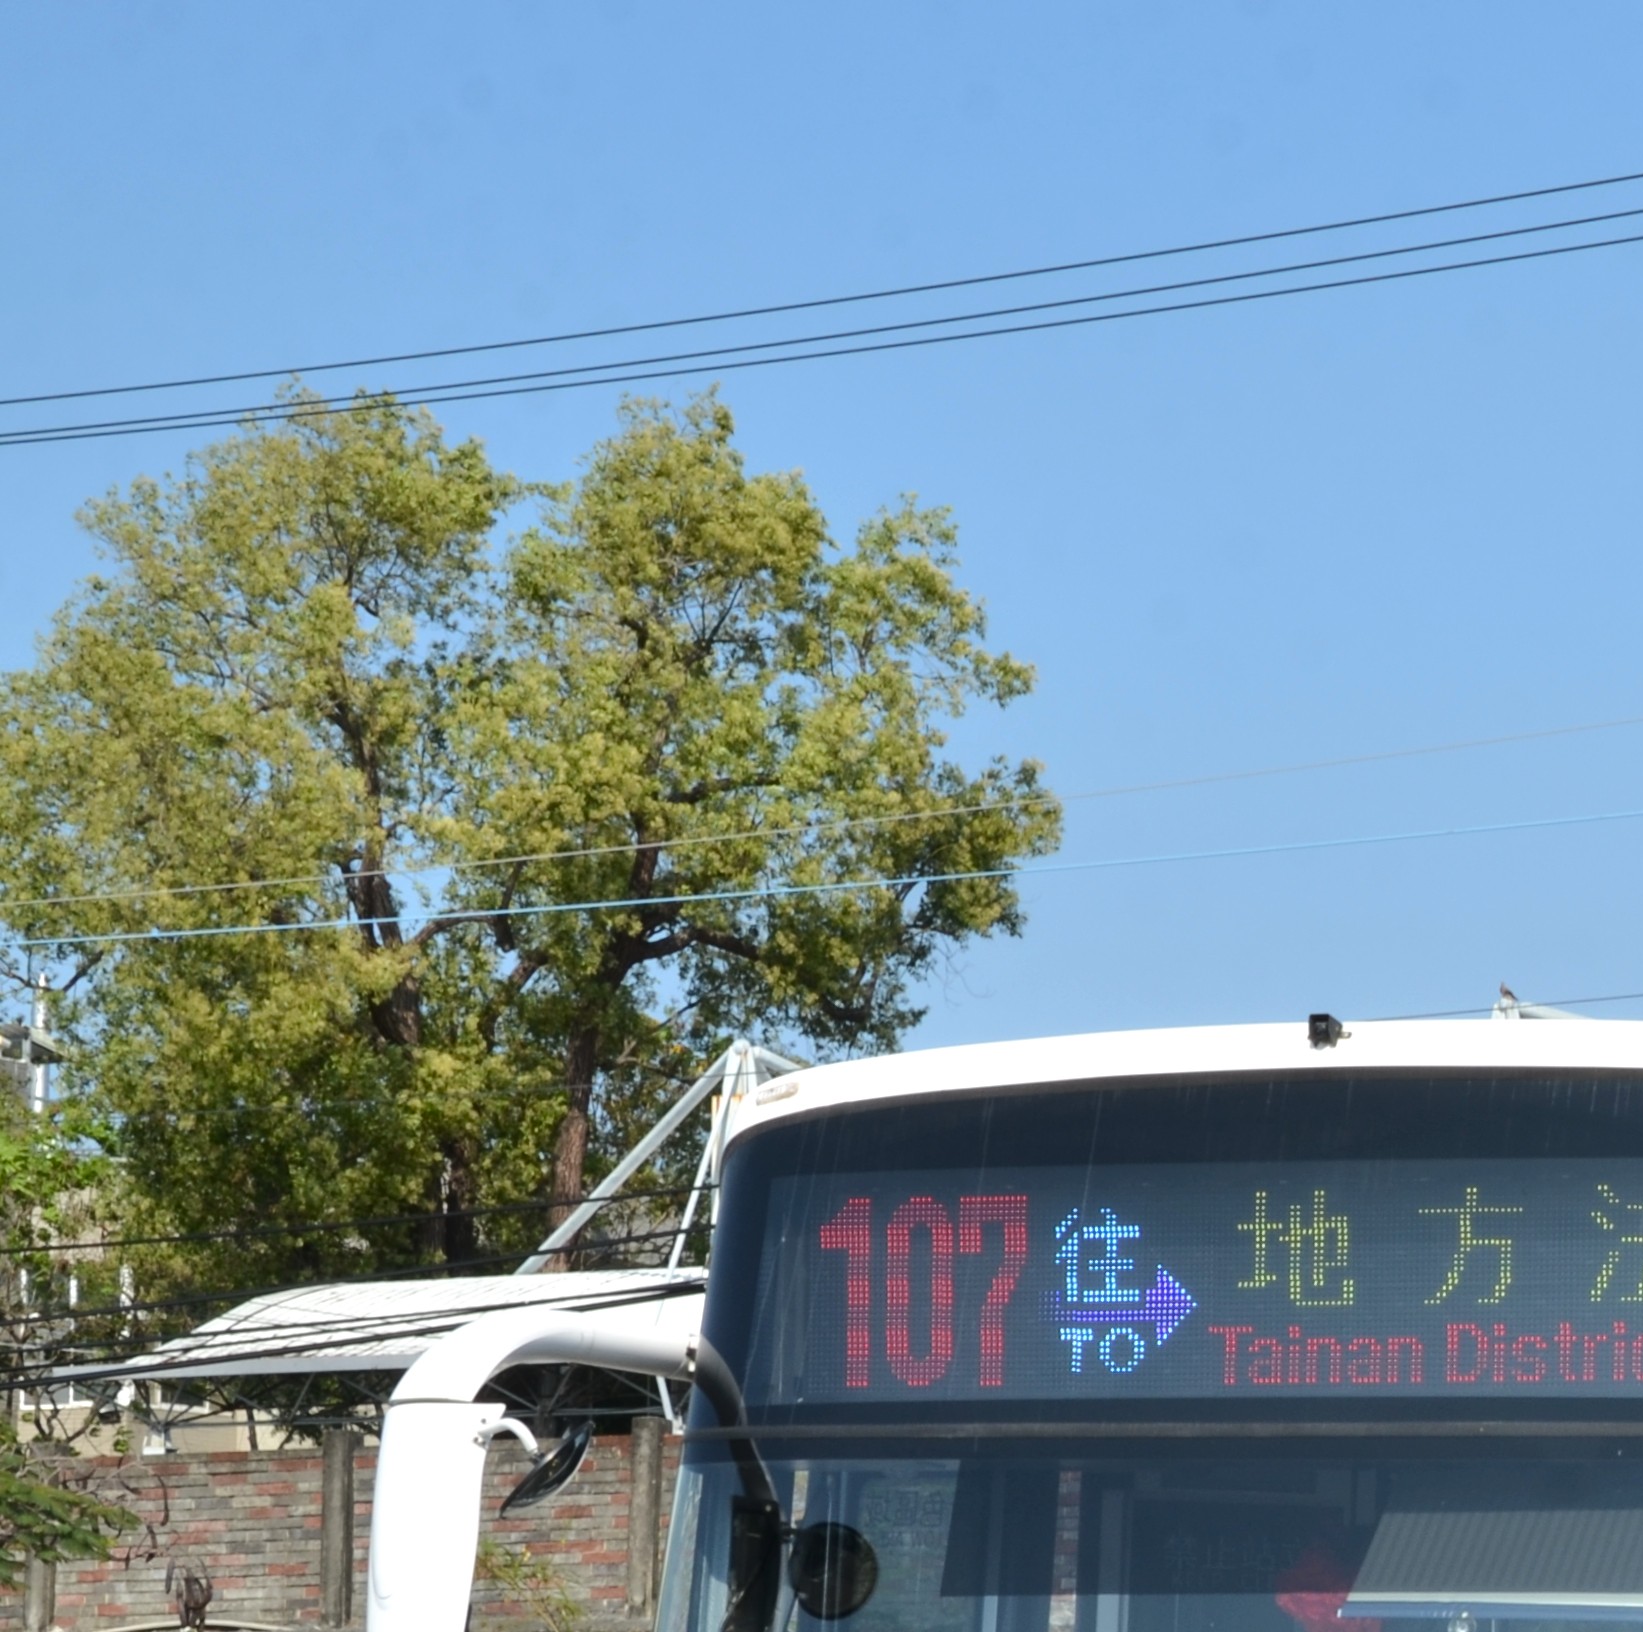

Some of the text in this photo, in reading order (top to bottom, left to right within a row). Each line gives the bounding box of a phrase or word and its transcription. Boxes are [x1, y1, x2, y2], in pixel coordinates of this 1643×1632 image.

[819, 1193, 1029, 1389] 107
[1055, 1206, 1142, 1304] 往
[1060, 1326, 1146, 1373] TO
[1208, 1324, 1425, 1386] Tainan
